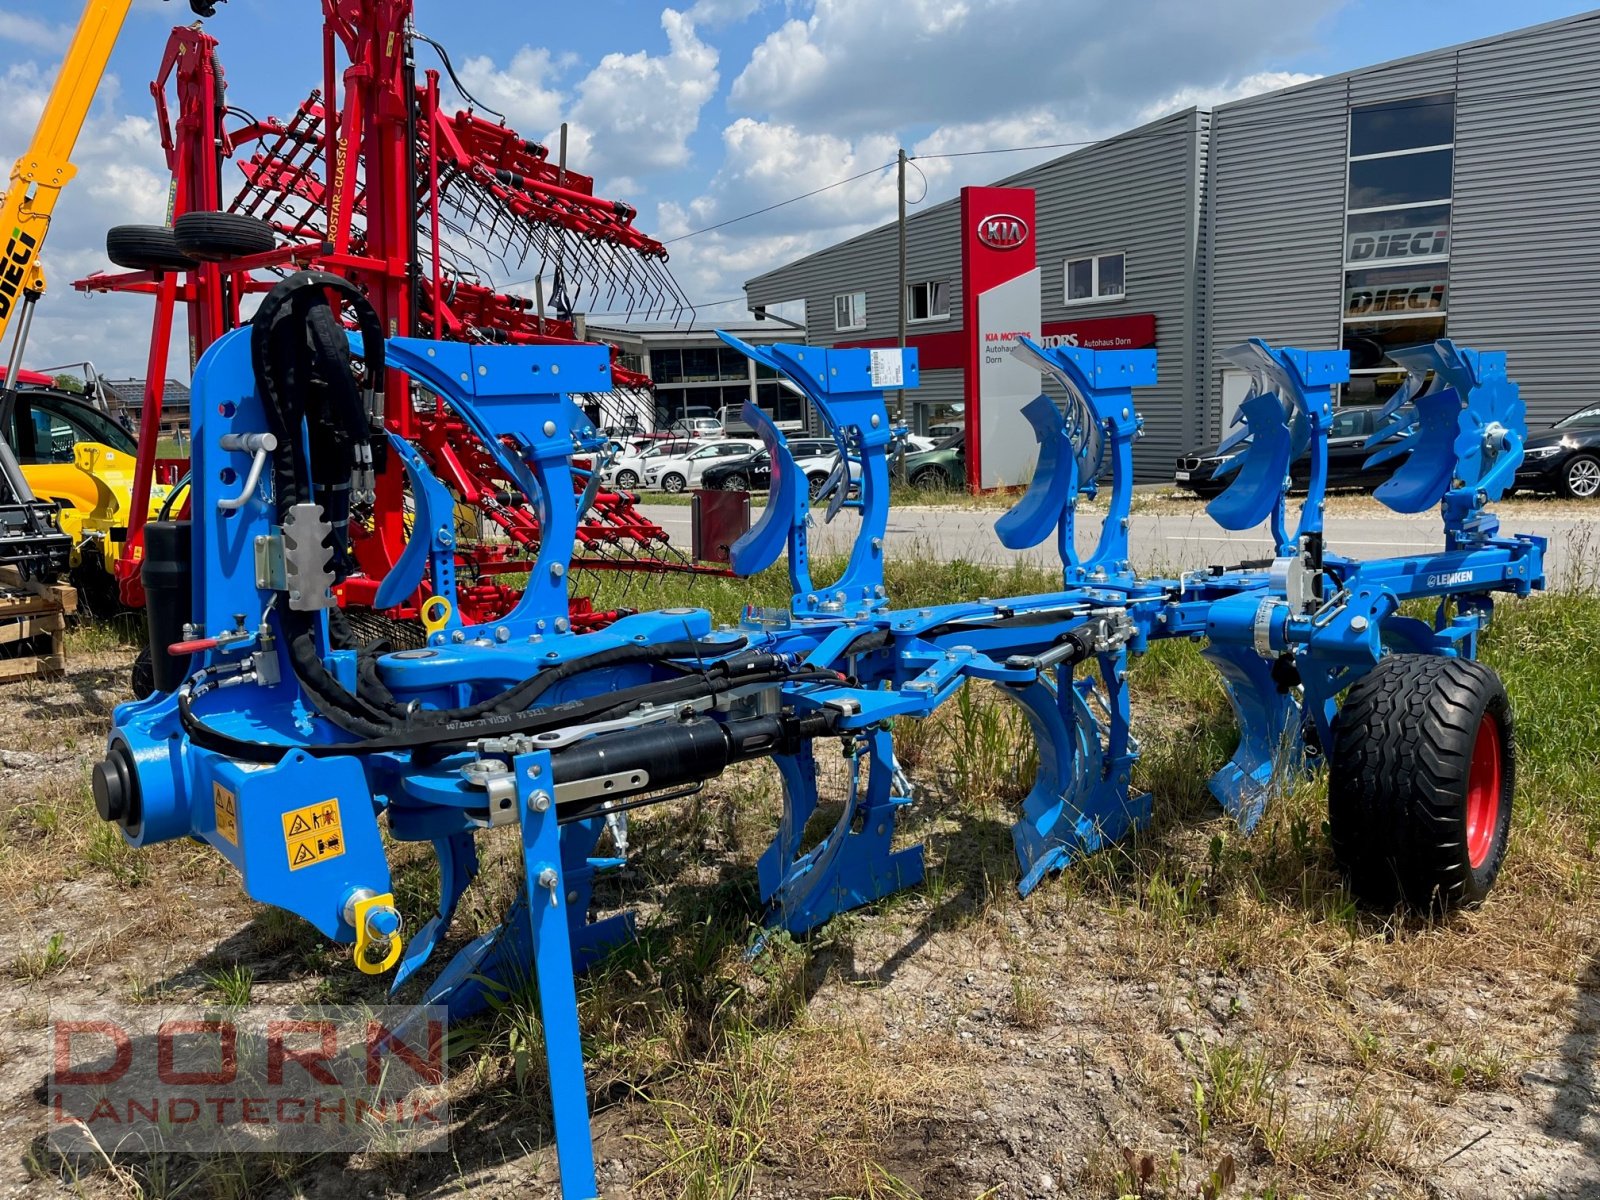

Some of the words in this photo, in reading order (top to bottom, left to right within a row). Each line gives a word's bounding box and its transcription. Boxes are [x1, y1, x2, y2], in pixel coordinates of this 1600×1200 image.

[987, 221, 1021, 240] KIA
[1350, 231, 1448, 259] DIECI
[1348, 285, 1446, 314] DIECI
[985, 333, 999, 342] KIA
[1083, 339, 1114, 348] Autohaus
[1115, 337, 1132, 346] Dorn
[985, 344, 1016, 353] Autohau
[985, 355, 1002, 364] Dorn
[1436, 570, 1474, 586] LEMKEN
